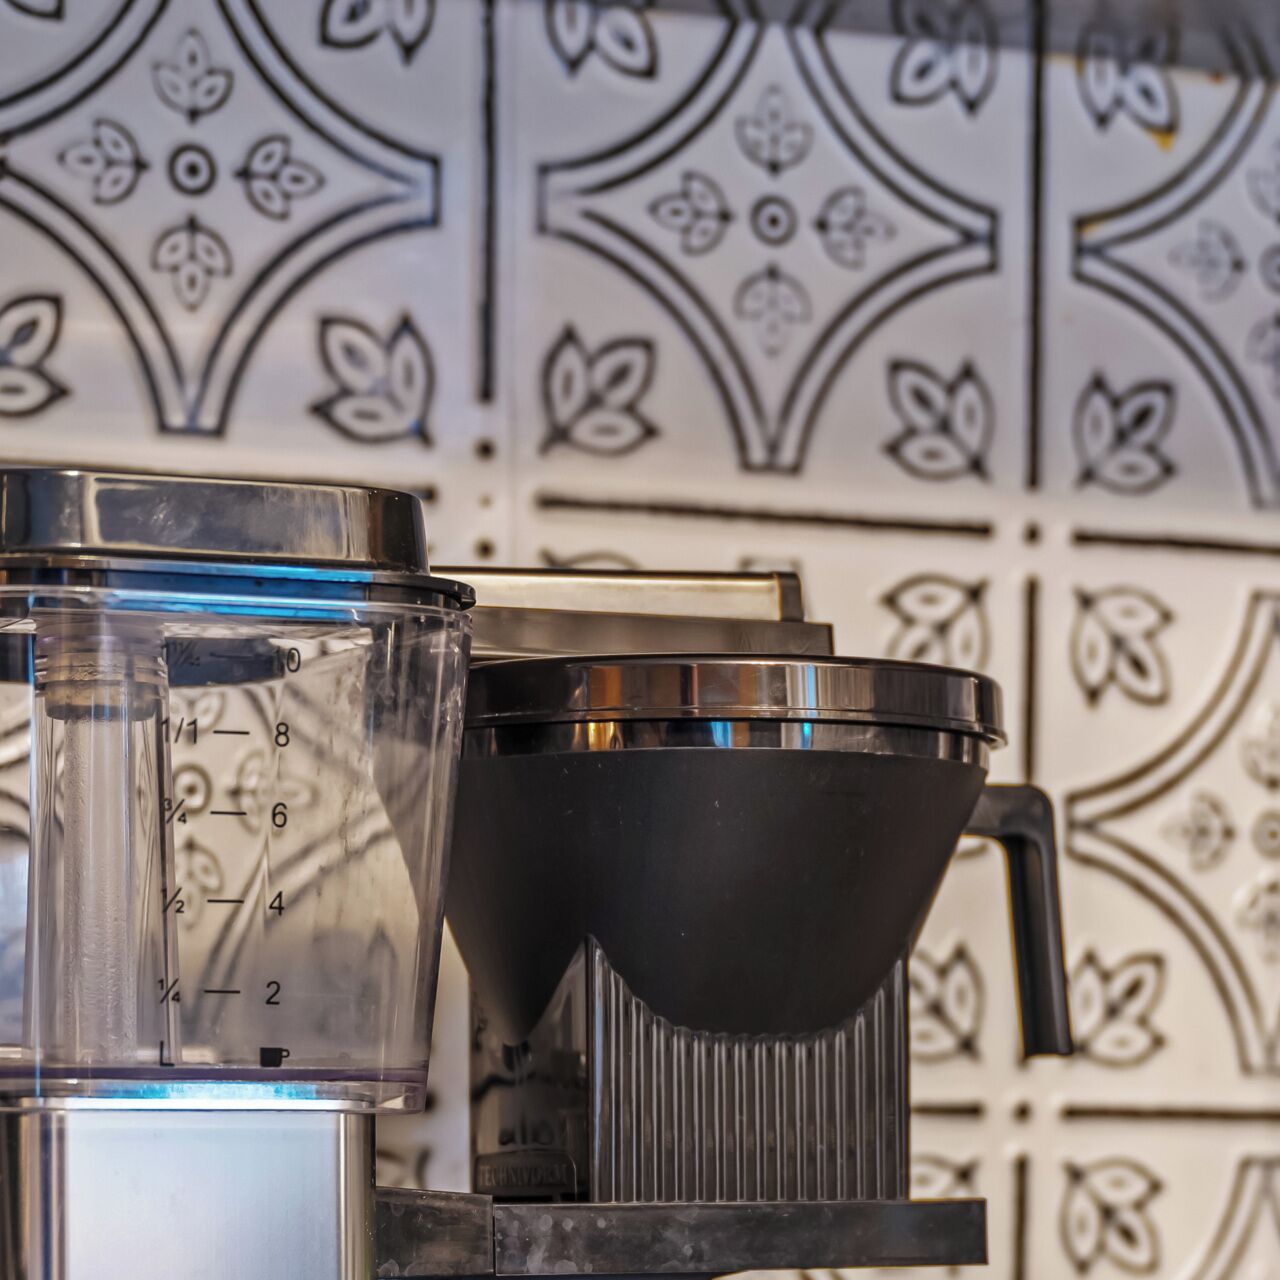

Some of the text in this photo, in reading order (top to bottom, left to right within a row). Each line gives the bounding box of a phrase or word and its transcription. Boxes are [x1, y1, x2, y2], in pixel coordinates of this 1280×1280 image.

[161, 717, 290, 747] 1/1 8
[271, 802, 288, 828] 6
[269, 891, 285, 916] 4
[265, 981, 281, 1005] 2
[160, 1041, 175, 1067] L
